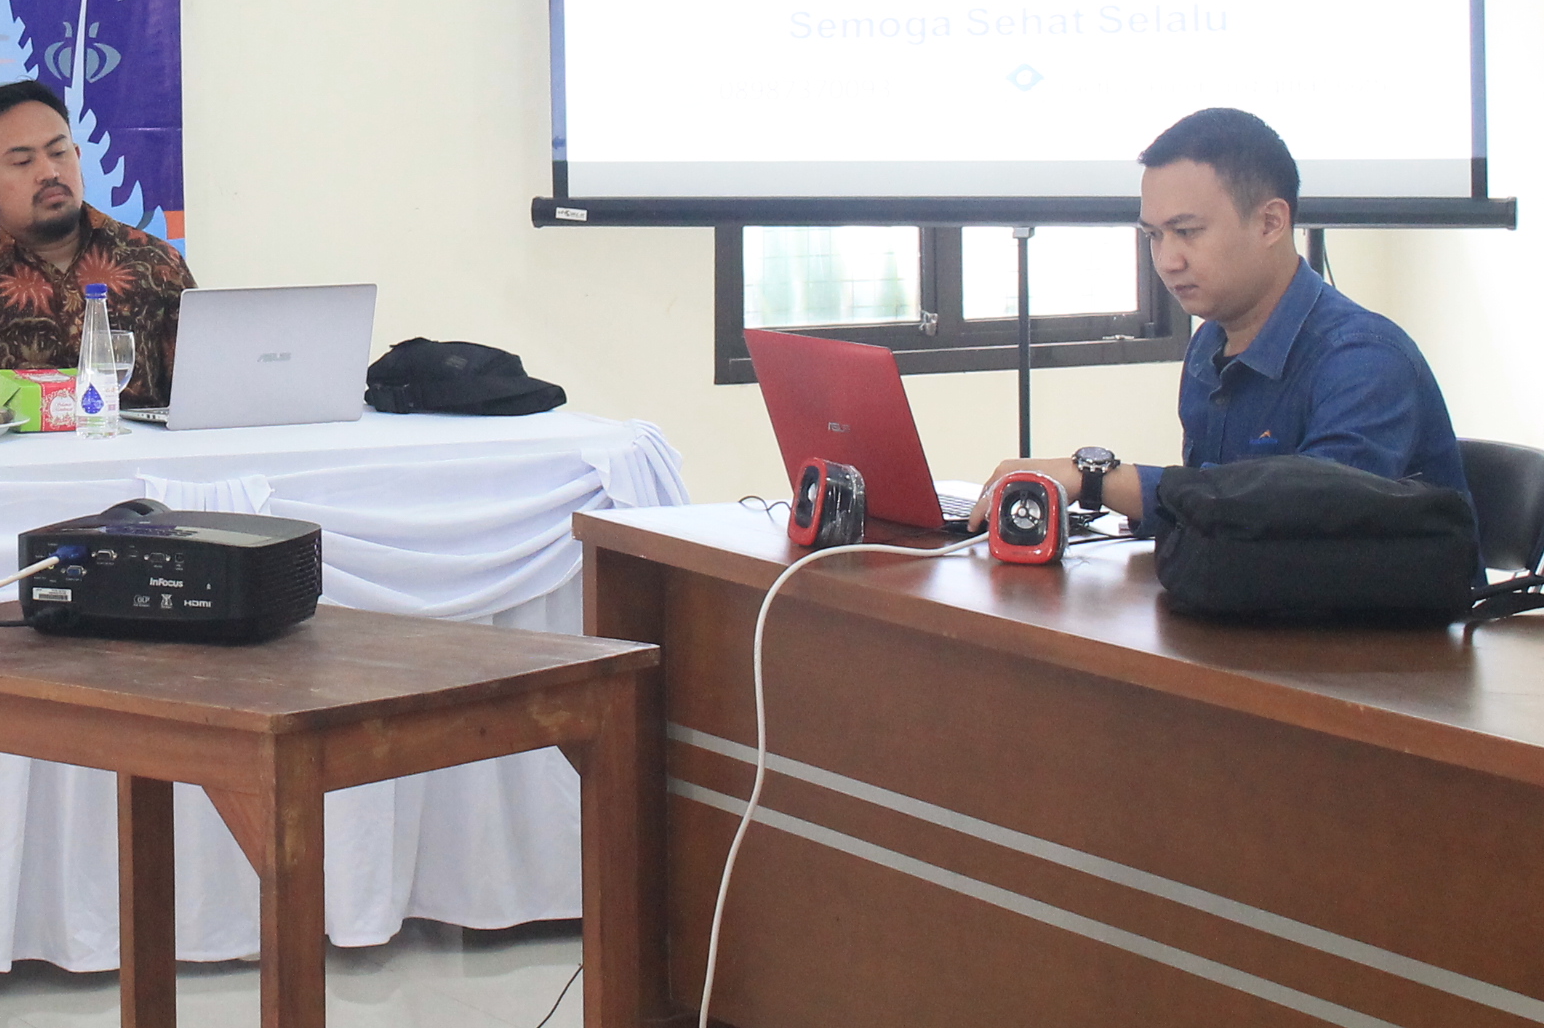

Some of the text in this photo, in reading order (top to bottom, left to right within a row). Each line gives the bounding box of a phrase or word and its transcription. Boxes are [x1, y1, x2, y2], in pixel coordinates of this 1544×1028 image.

[788, 2, 1229, 46] Semoga Sehat Selalu
[149, 577, 184, 588] InFocus
